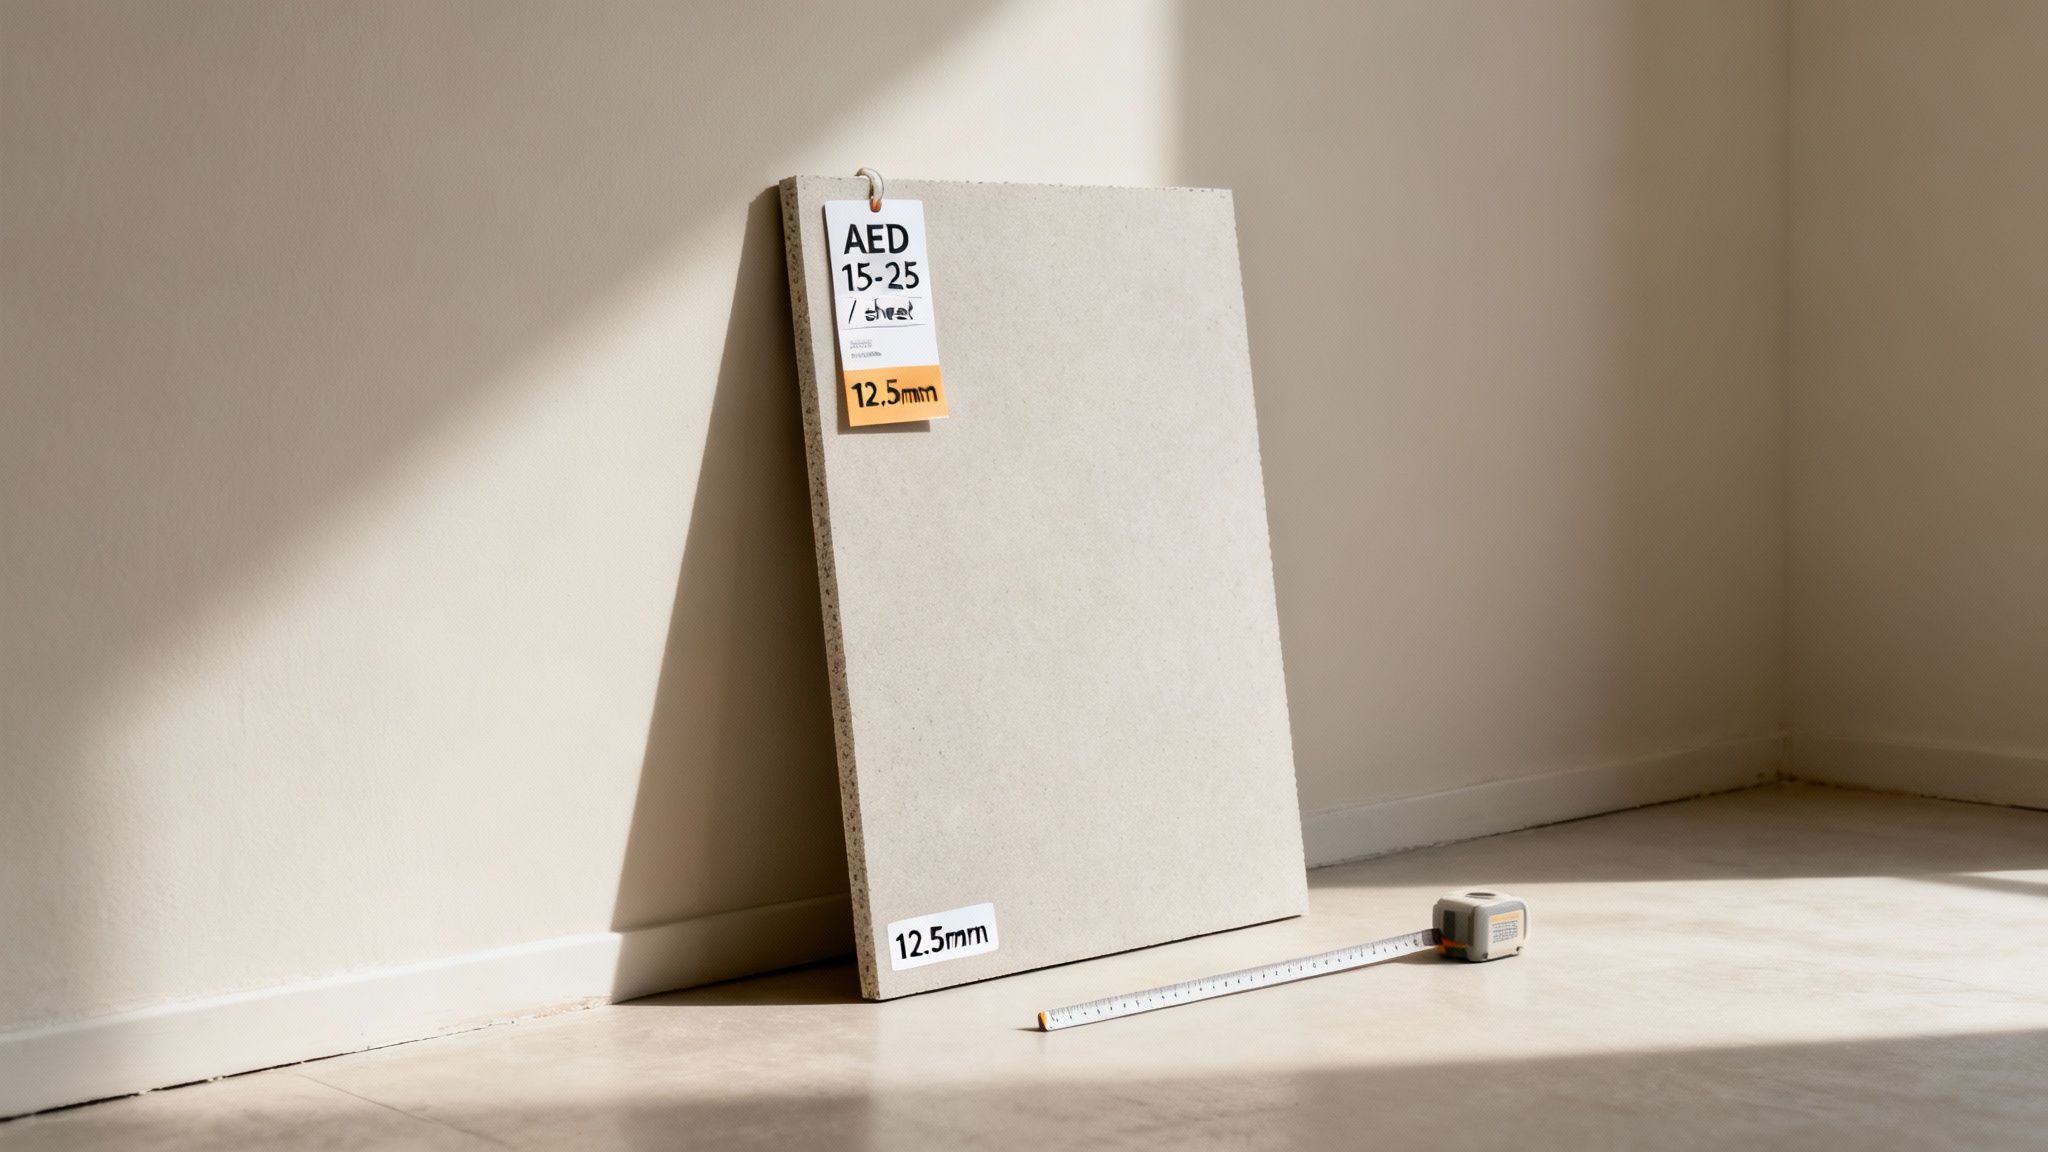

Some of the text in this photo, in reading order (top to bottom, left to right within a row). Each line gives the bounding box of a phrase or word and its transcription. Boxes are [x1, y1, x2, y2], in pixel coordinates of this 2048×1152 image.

[844, 223, 909, 254] AED
[842, 261, 919, 291] 15-25
[895, 925, 988, 959] 12.5mm
